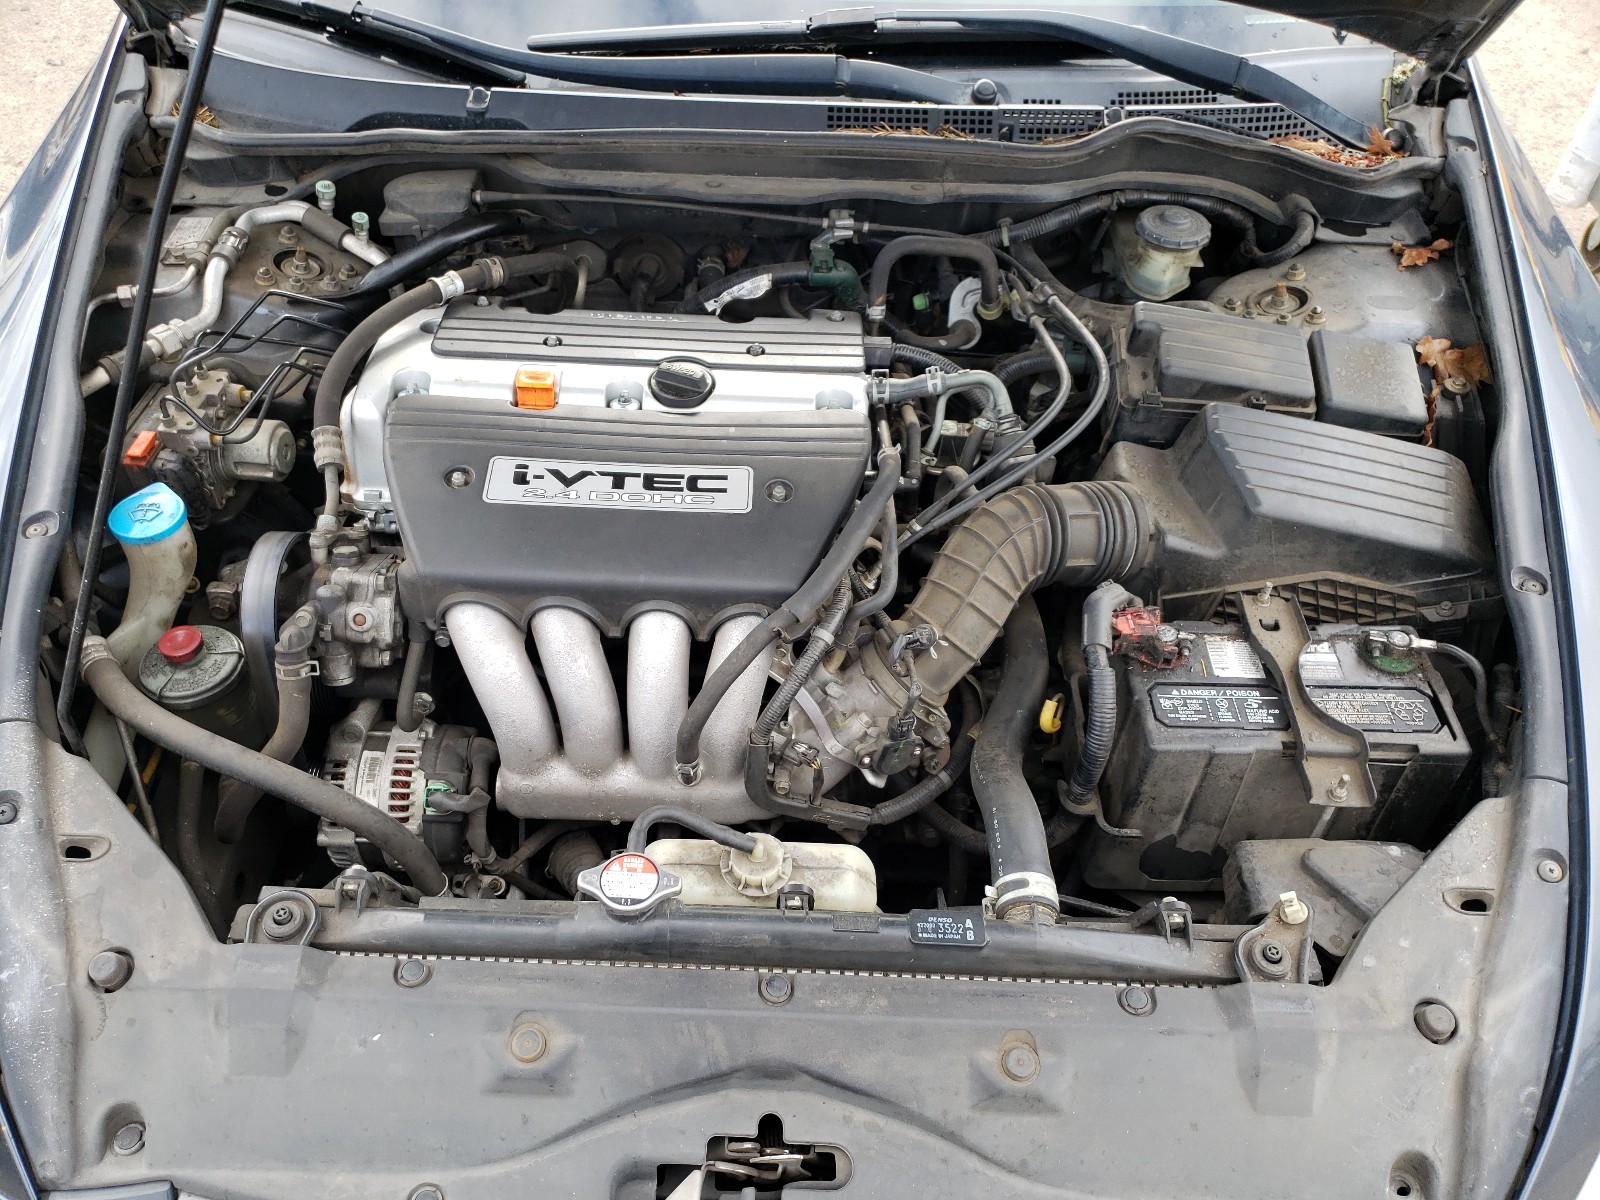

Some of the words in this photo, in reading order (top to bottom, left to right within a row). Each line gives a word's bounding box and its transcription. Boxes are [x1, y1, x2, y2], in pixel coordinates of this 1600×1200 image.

[512, 463, 728, 494] i-VTEC
[522, 487, 581, 500] 2.4
[588, 491, 715, 505] DOHC
[938, 923, 964, 934] 3522
[965, 918, 974, 929] A
[966, 930, 975, 941] B
